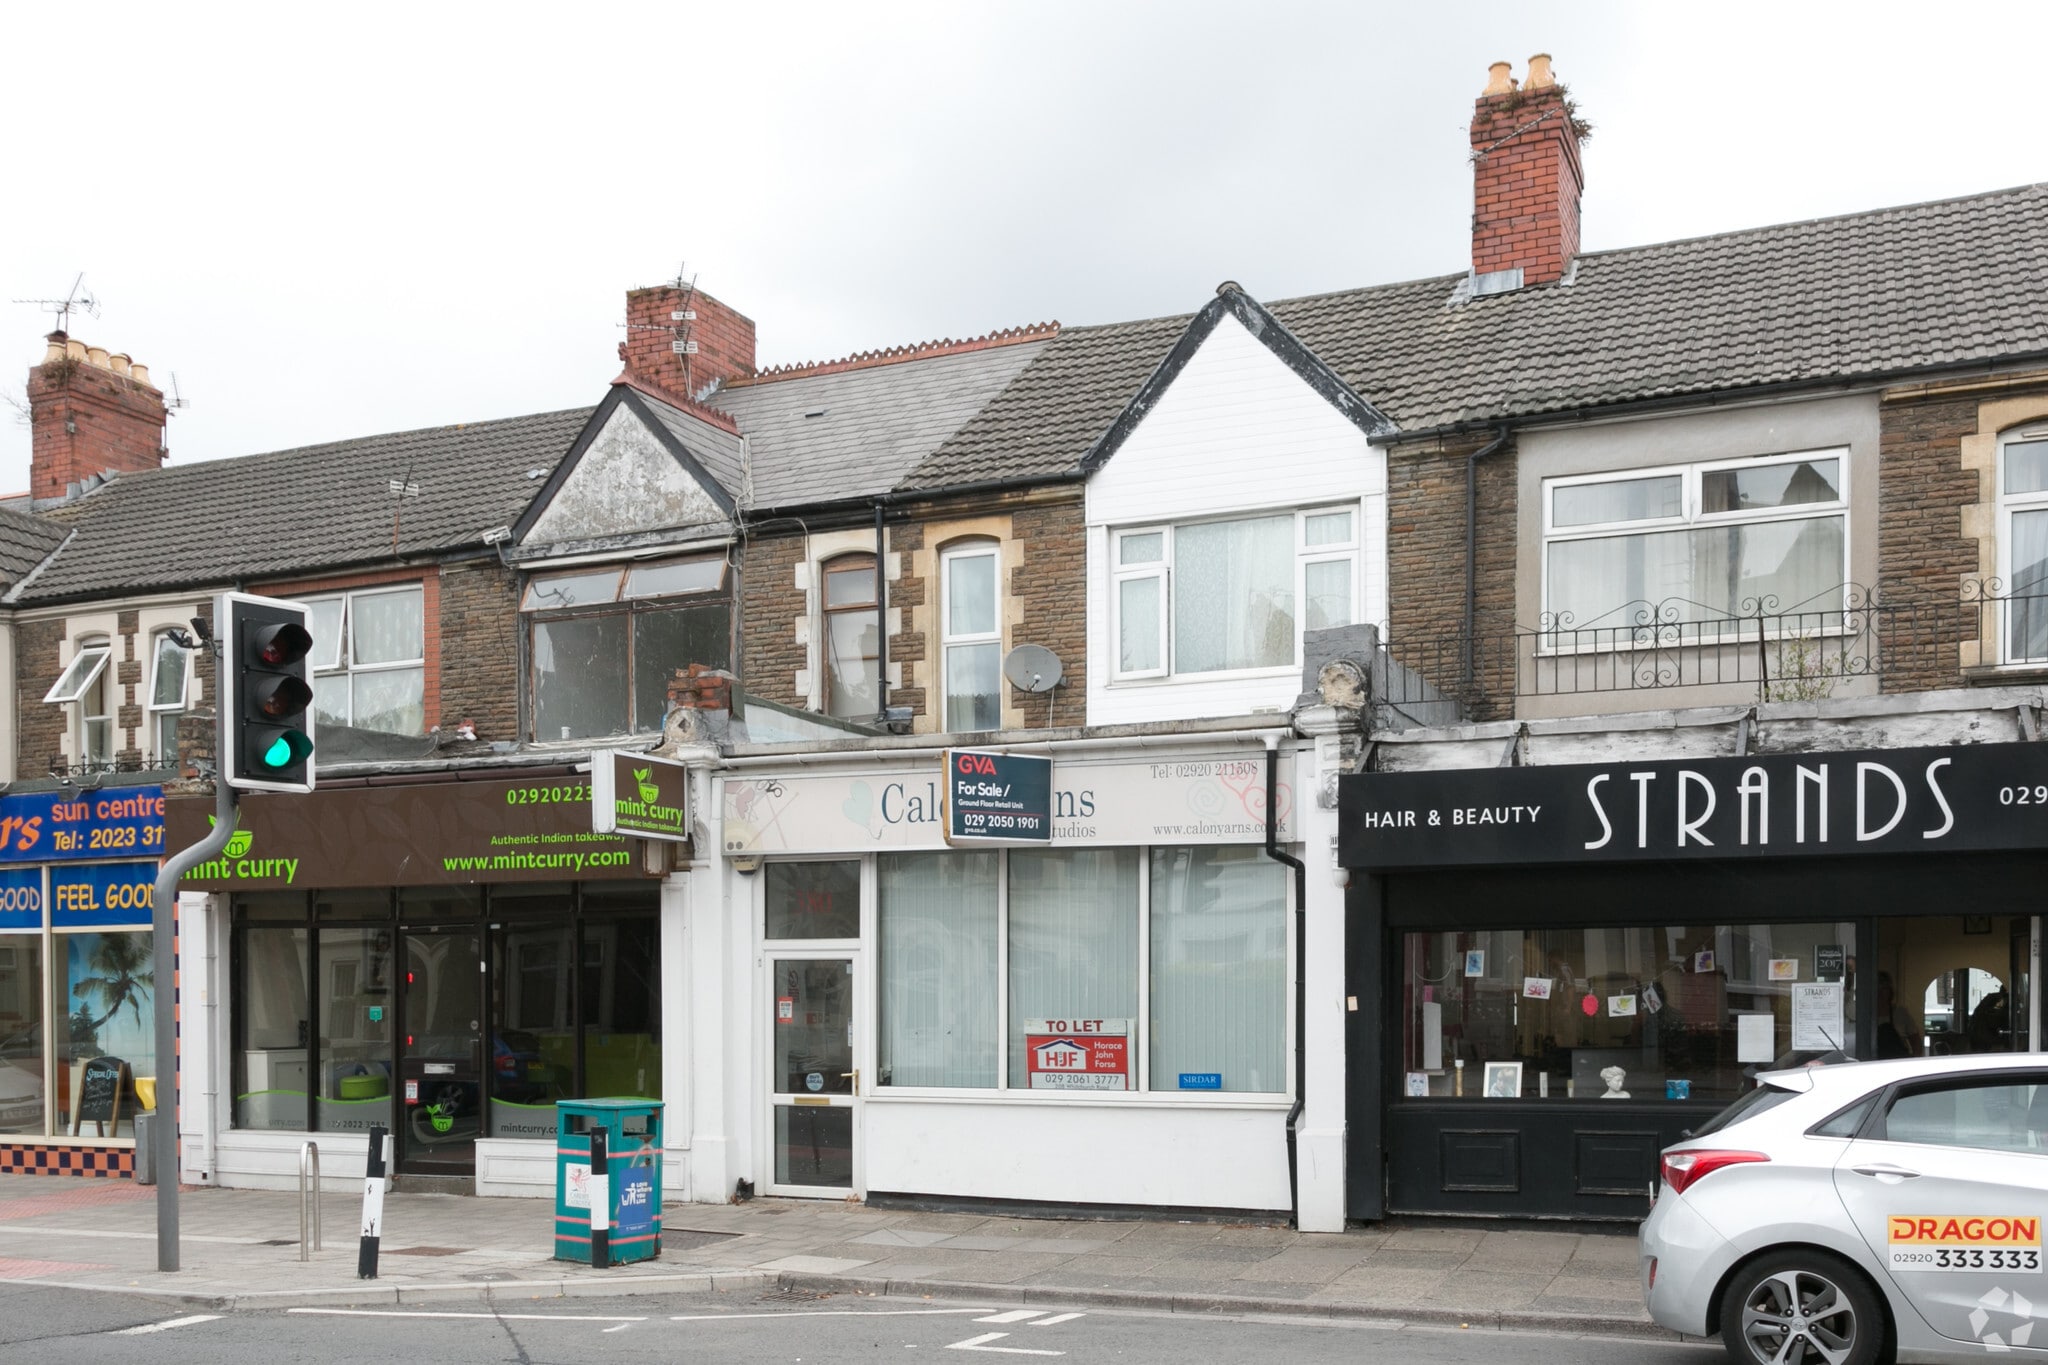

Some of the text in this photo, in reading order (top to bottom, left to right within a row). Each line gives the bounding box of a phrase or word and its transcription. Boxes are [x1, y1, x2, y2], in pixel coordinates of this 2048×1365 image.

[957, 755, 997, 776] GVA
[1150, 761, 1258, 779] Tel: 02920 211508
[957, 781, 977, 796] For
[978, 783, 1003, 798] Sale
[51, 794, 165, 822] sun centre
[616, 796, 683, 826] mint curry
[957, 799, 1024, 810] Ground Floor Retail Unit
[1584, 757, 1955, 850] STRANDS
[964, 814, 1039, 830] 029 2050 1901
[1365, 806, 1541, 828] HAIR & BEAUTY
[53, 825, 165, 850] Tel: 2023 31
[490, 833, 539, 846] Authentic
[541, 832, 573, 844] Indian
[443, 850, 630, 872] www.mintcurry.com
[236, 858, 299, 884] curry
[56, 883, 100, 911] FEEL
[1045, 1020, 1104, 1033] TO LET
[1094, 1041, 1122, 1050] Horace
[1095, 1051, 1114, 1059] John
[1095, 1060, 1116, 1068] Forse
[1045, 1074, 1120, 1085] 029 2061 3777
[1183, 1075, 1217, 1084] SIRDAR
[1893, 1219, 2036, 1241] DRAGON
[1893, 1249, 2039, 1269] 02920 333 333
